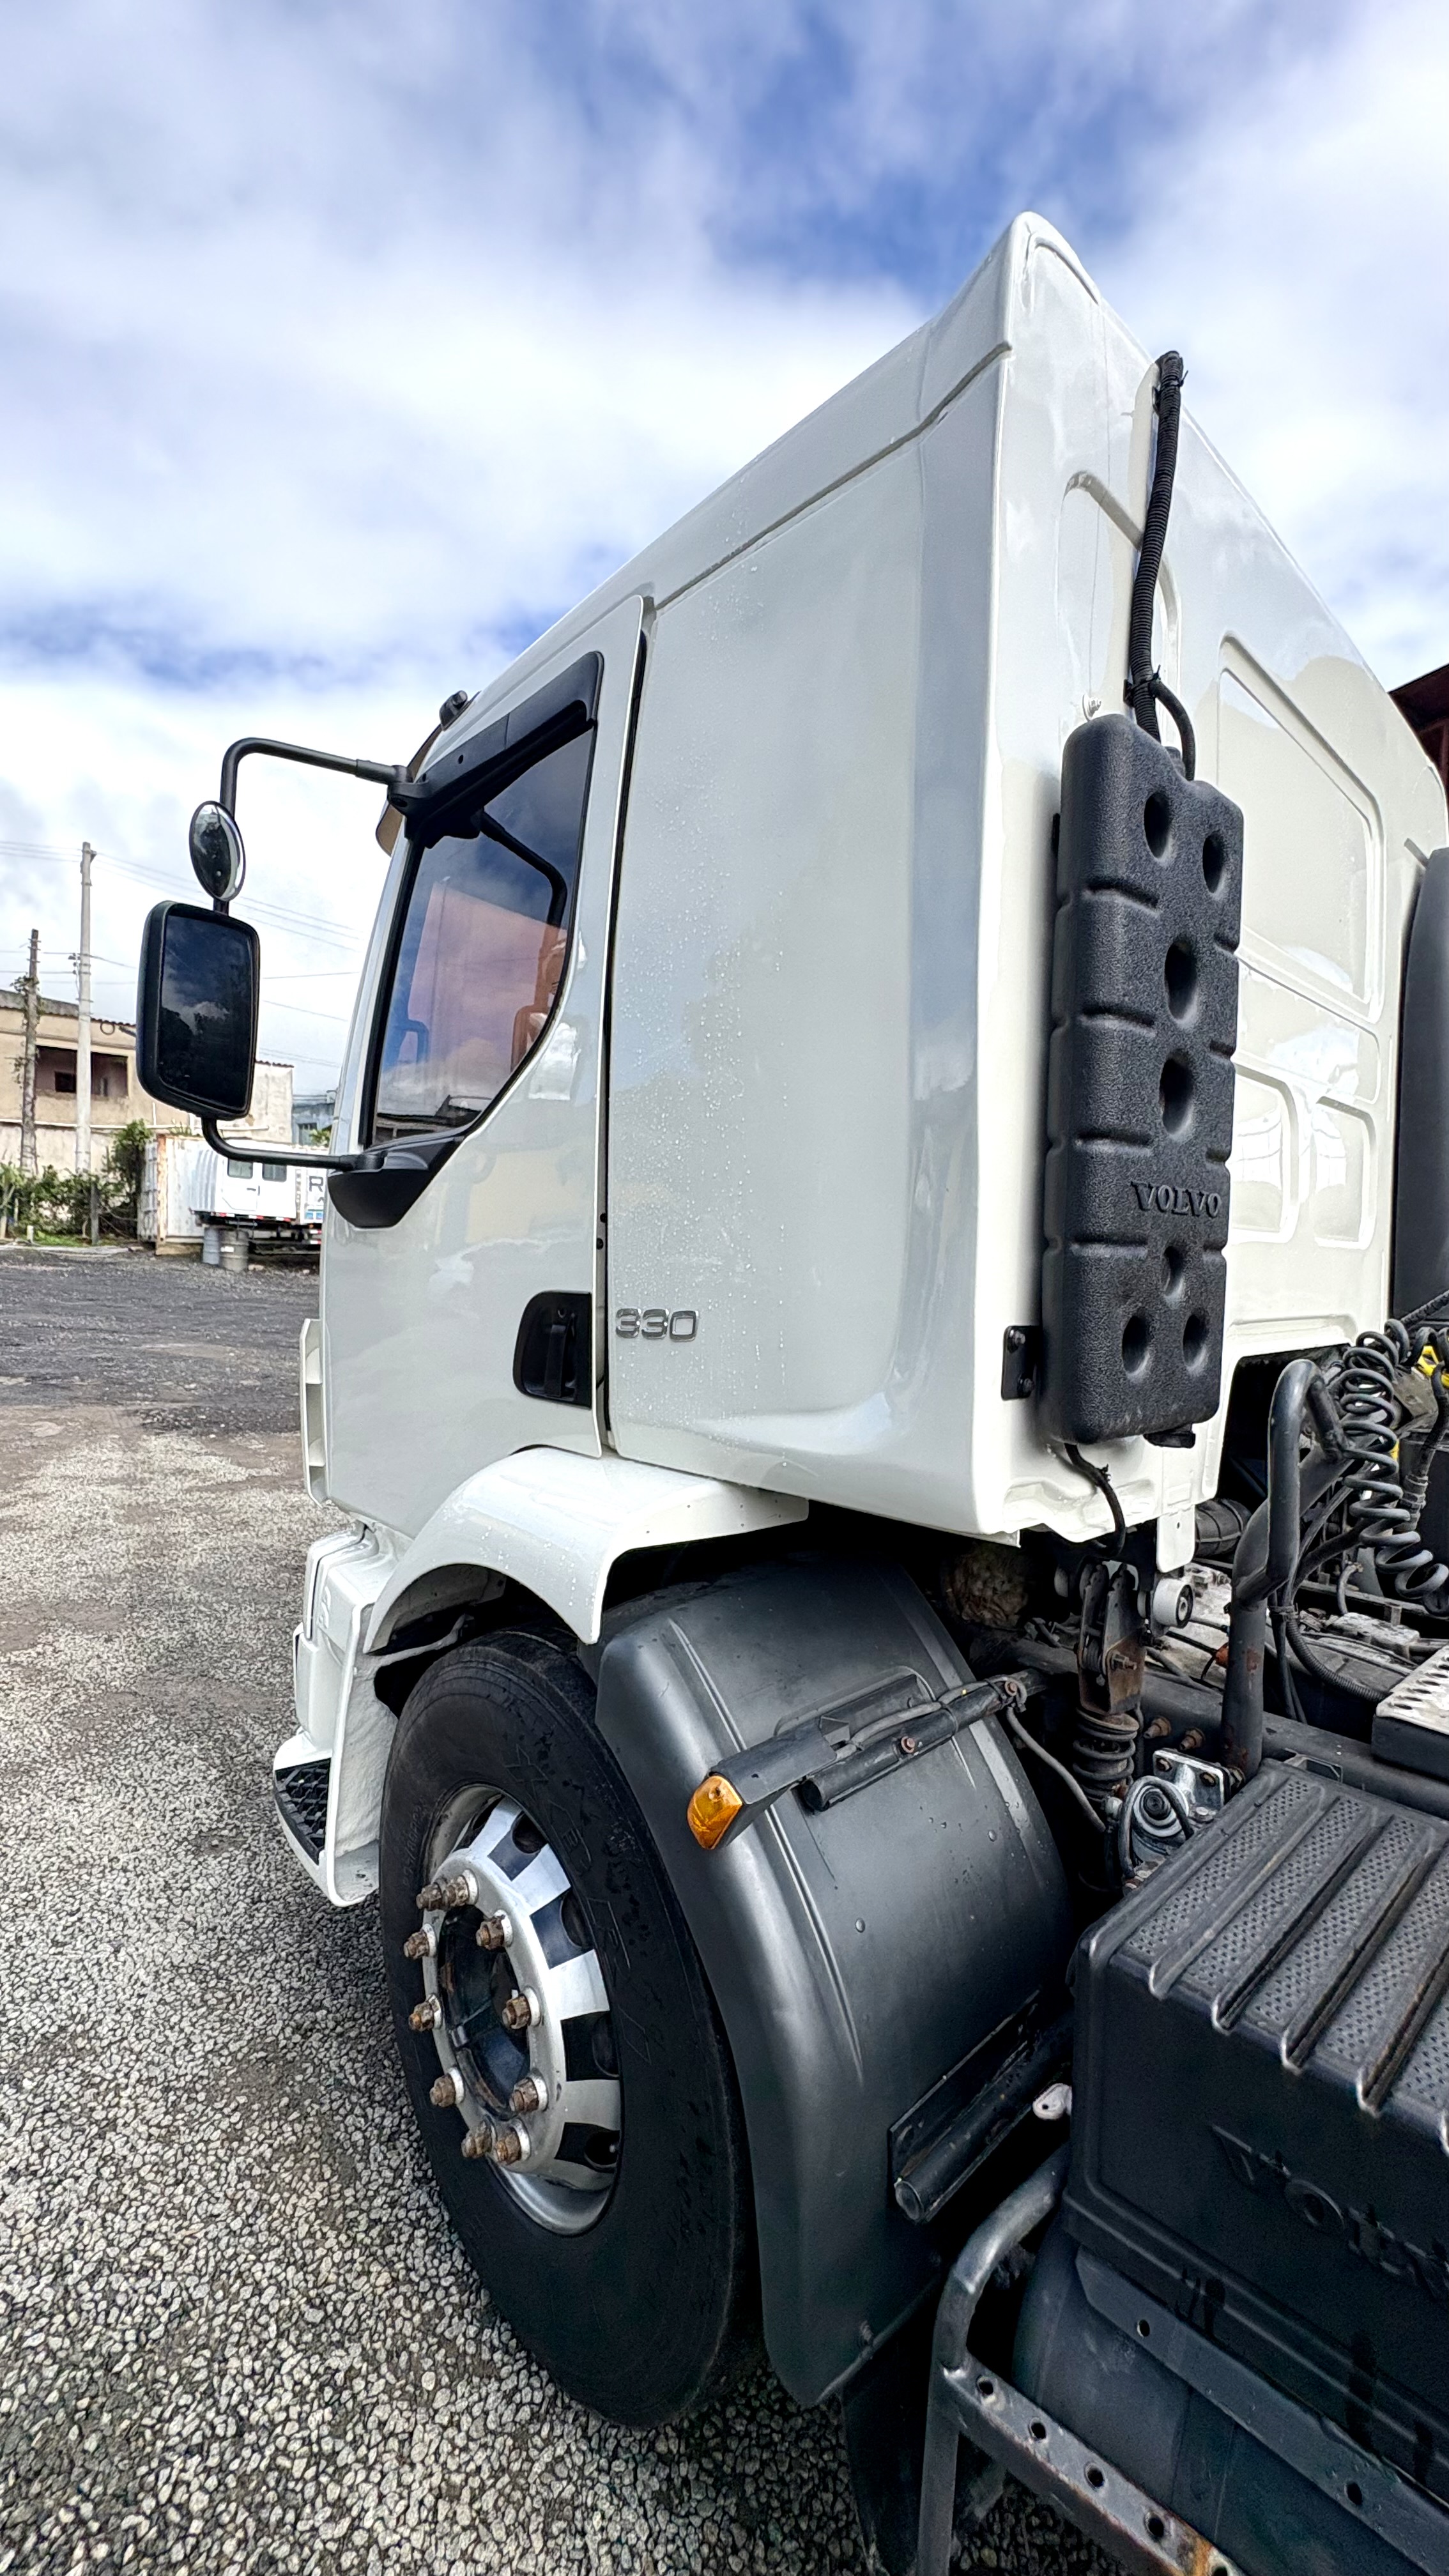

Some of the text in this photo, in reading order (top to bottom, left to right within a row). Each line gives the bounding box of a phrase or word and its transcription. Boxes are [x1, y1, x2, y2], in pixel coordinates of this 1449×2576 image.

[1130, 1181, 1222, 1218] VOLVO
[616, 1308, 699, 1342] 330
[1211, 2123, 1449, 2300] VOLV
